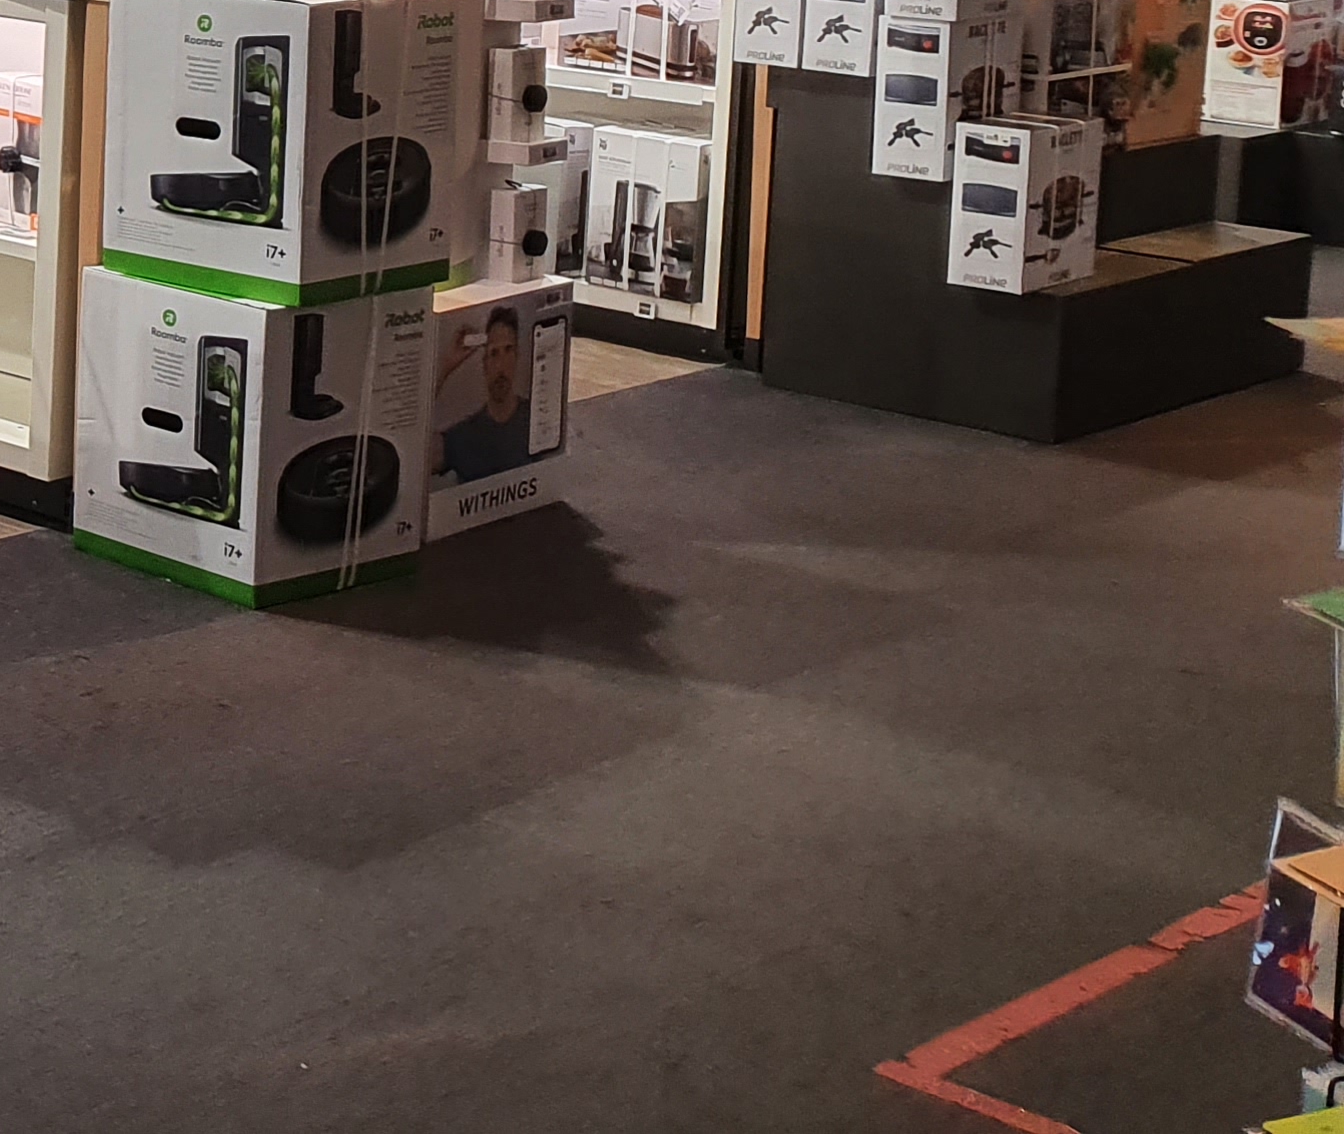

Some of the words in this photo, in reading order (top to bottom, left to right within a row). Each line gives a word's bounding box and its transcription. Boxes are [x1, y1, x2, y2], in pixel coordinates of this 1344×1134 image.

[183, 34, 224, 48] Roomba
[264, 242, 287, 261] i7+
[150, 325, 188, 344] Roomba
[457, 476, 539, 518] WITHINGS
[223, 540, 243, 560] i7+
